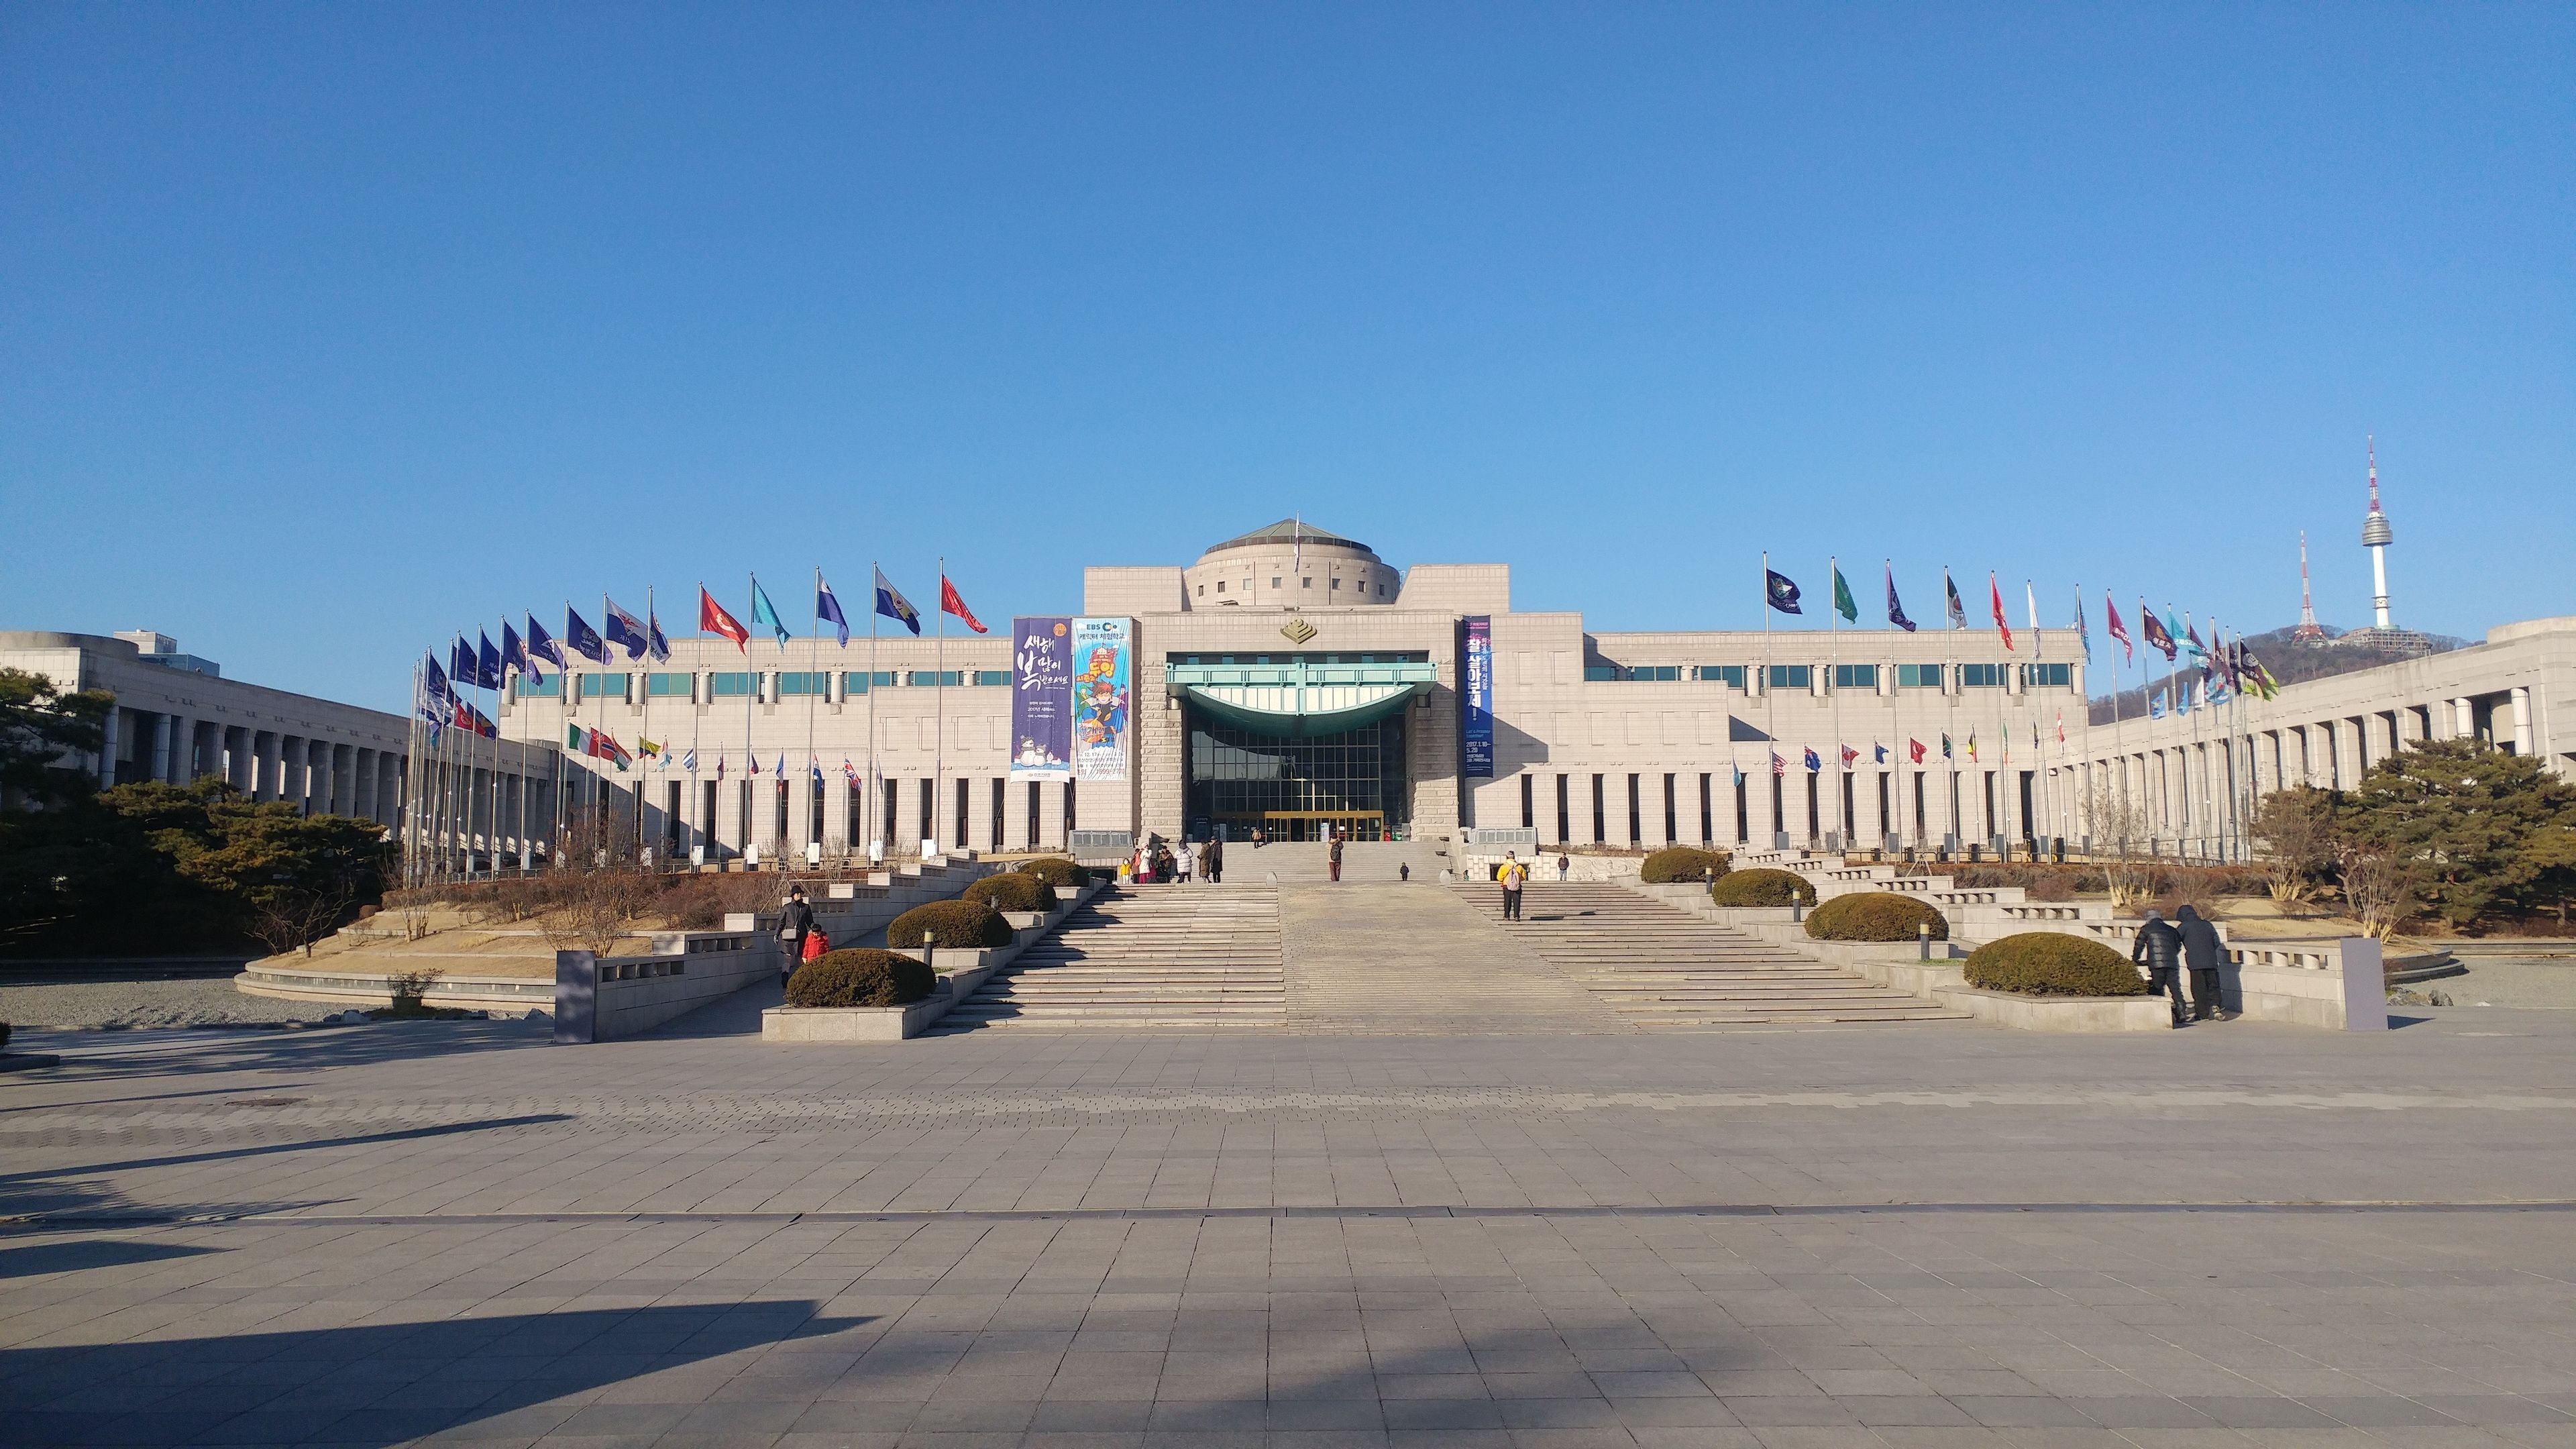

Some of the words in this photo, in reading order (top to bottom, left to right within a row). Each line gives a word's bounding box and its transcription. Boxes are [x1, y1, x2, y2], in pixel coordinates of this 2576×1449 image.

[1023, 635, 1055, 654] 새해
[1467, 639, 1481, 653] 잘
[1017, 650, 1041, 692] 복
[1037, 656, 1061, 673] 많이
[1039, 674, 1069, 686] 받으세요
